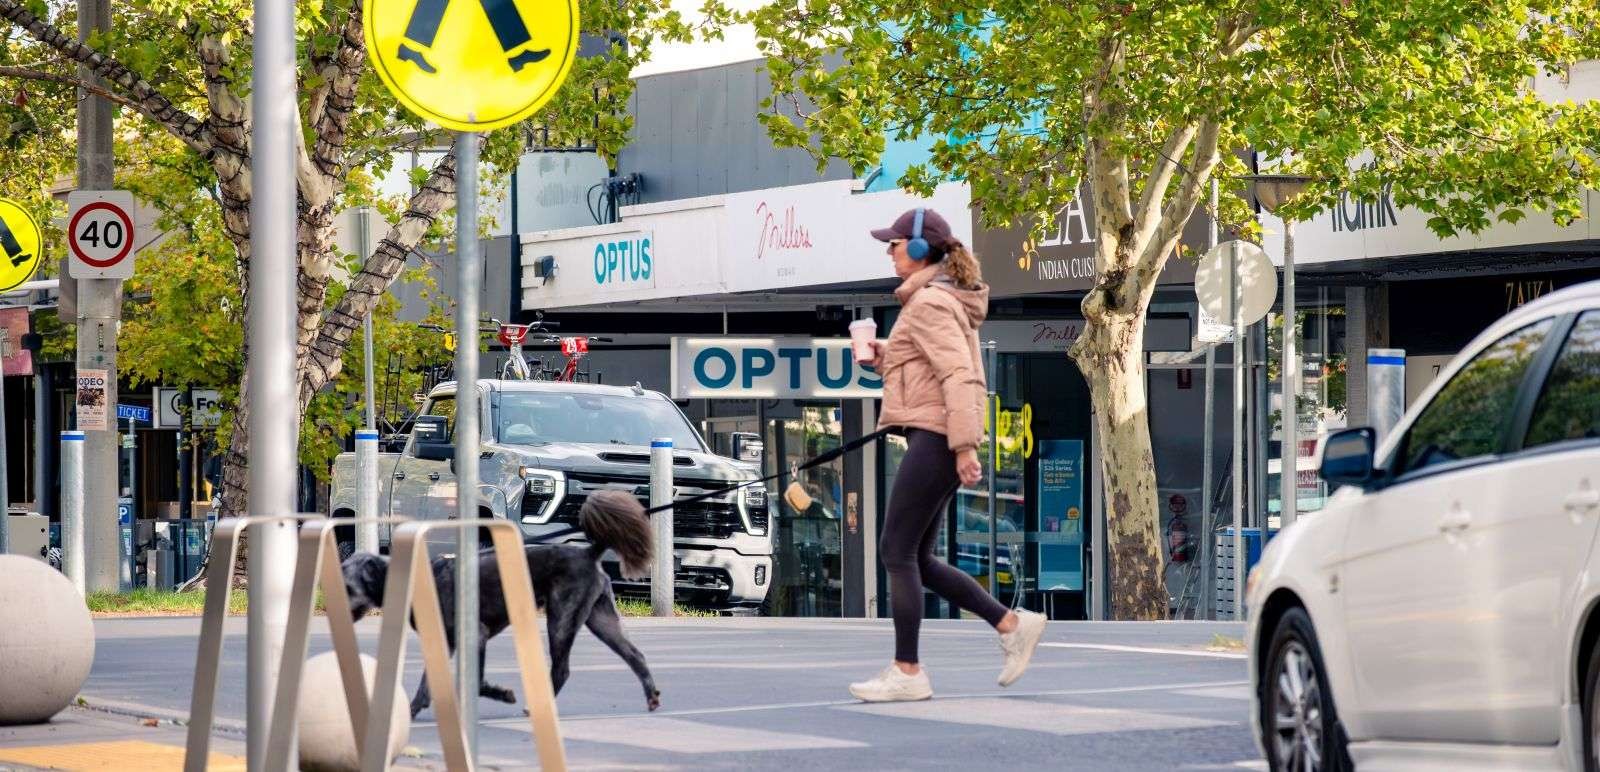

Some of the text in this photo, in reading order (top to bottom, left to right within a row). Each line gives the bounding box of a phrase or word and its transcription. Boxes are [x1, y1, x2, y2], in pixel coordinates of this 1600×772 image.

[80, 220, 123, 249] 40
[756, 201, 813, 260] Millers
[594, 238, 650, 284] OPTUS
[1038, 257, 1095, 281] INDIAN CUISI
[118, 406, 147, 420] TICKET
[118, 507, 128, 520] P
